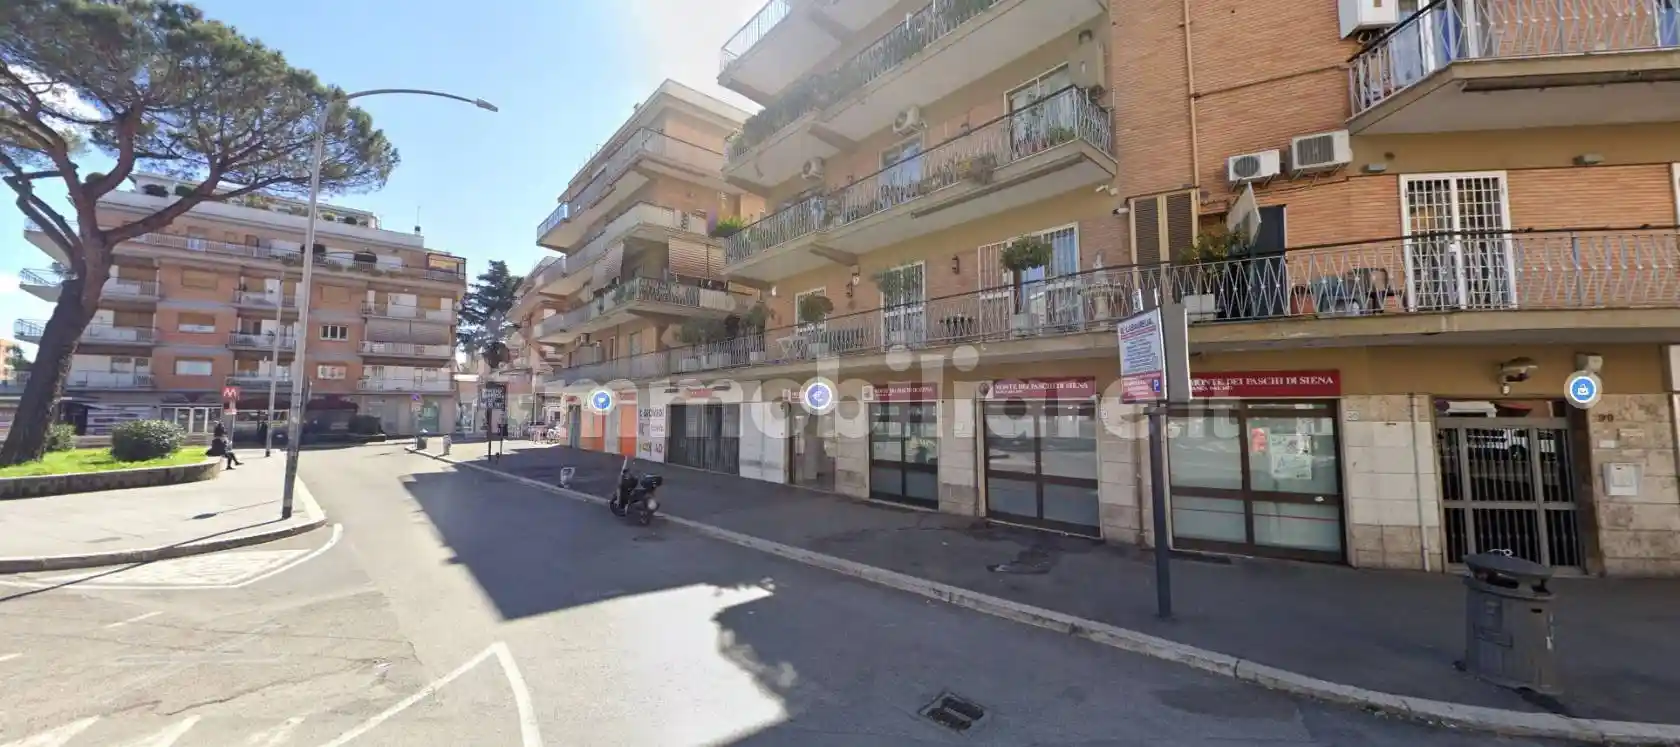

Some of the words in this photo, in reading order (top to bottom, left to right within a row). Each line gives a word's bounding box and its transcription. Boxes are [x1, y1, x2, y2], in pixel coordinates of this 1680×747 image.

[1065, 382, 1088, 390] SIENA
[1154, 379, 1160, 391] P
[1190, 378, 1224, 388] MONTE
[1227, 378, 1243, 386] DEI
[1246, 376, 1284, 386] PASCHI
[1287, 376, 1297, 385] DI
[1299, 375, 1334, 385] SIENA
